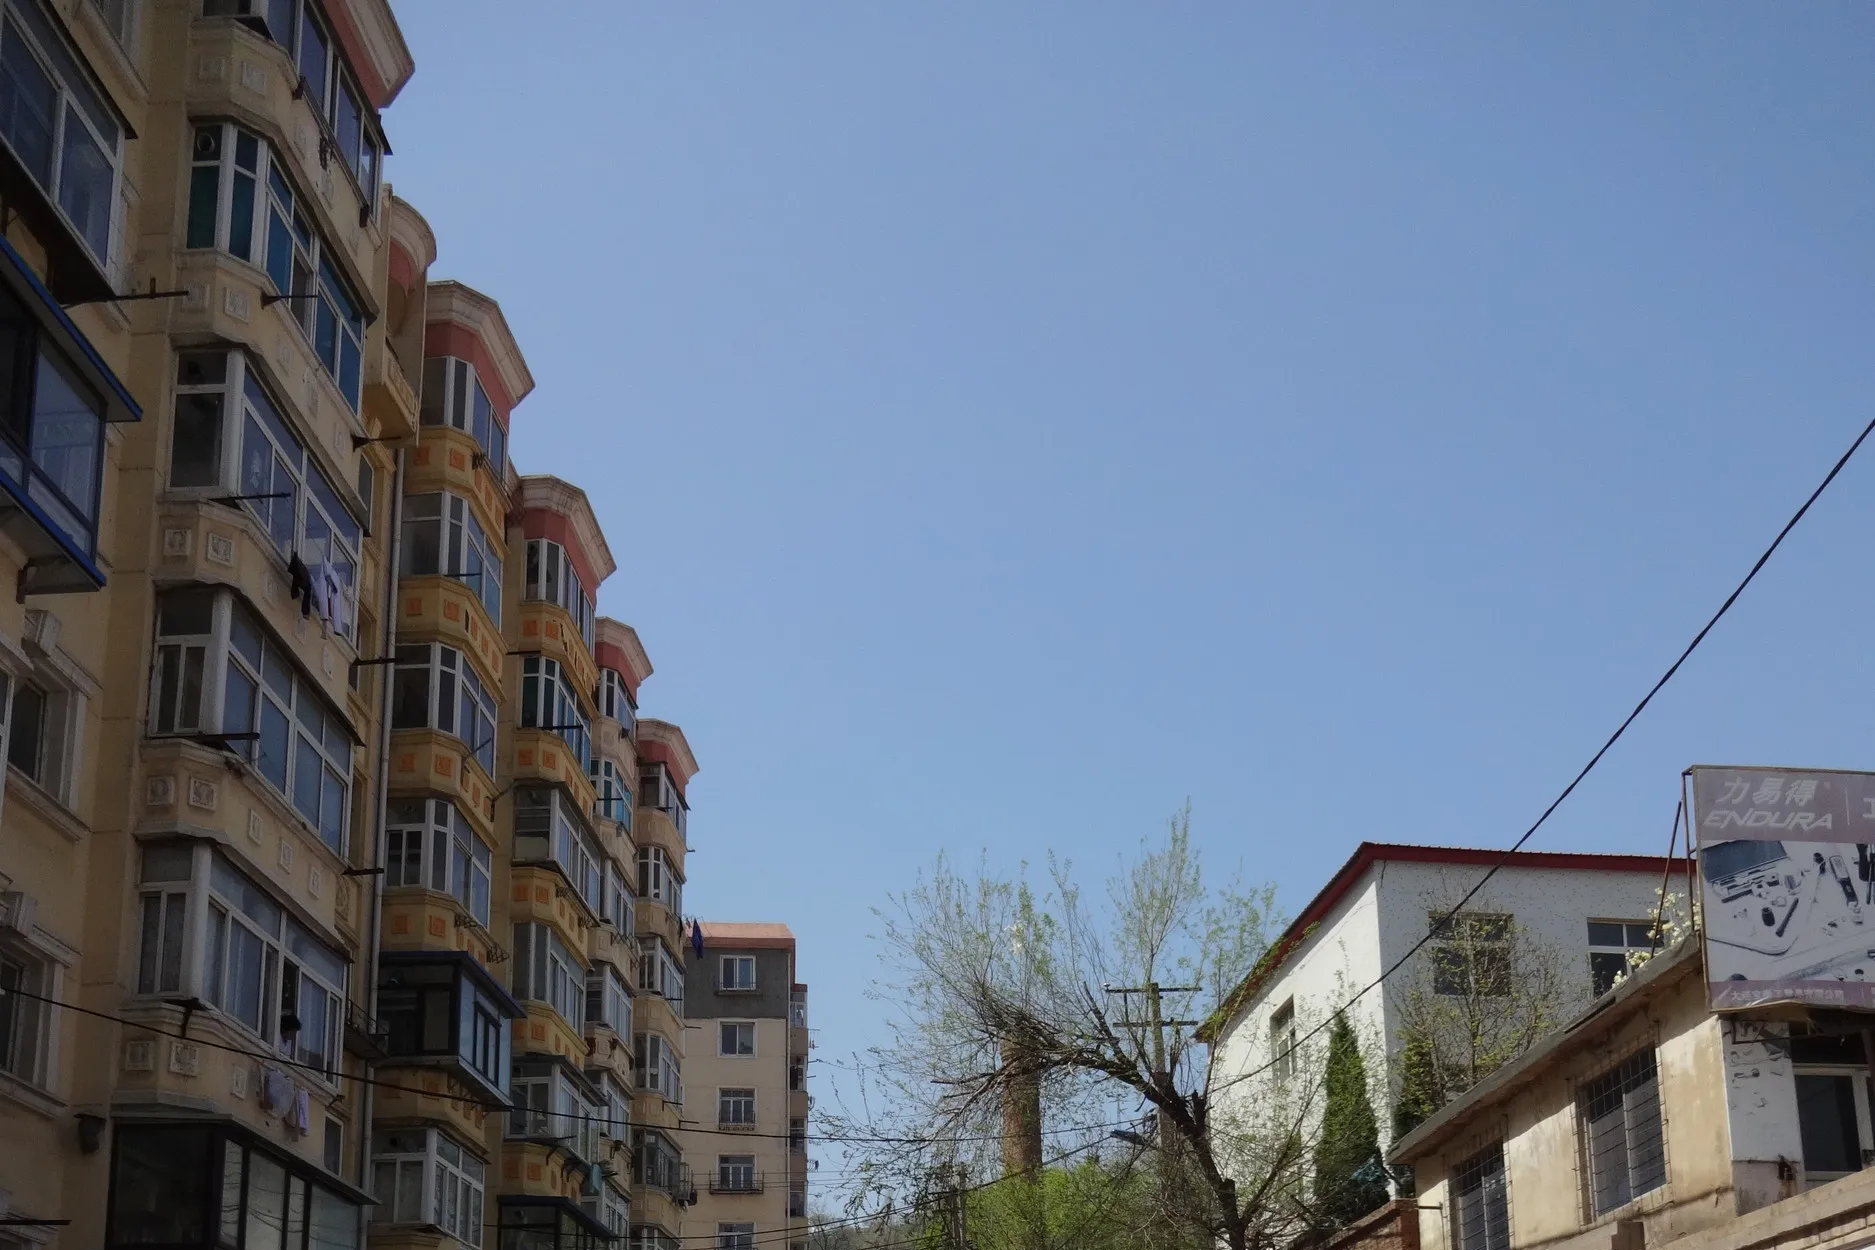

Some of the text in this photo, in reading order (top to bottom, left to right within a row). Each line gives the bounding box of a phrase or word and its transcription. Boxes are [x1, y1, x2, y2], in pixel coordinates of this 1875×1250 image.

[1716, 776, 1818, 806] 力易得
[1703, 808, 1833, 831] ENDURA
